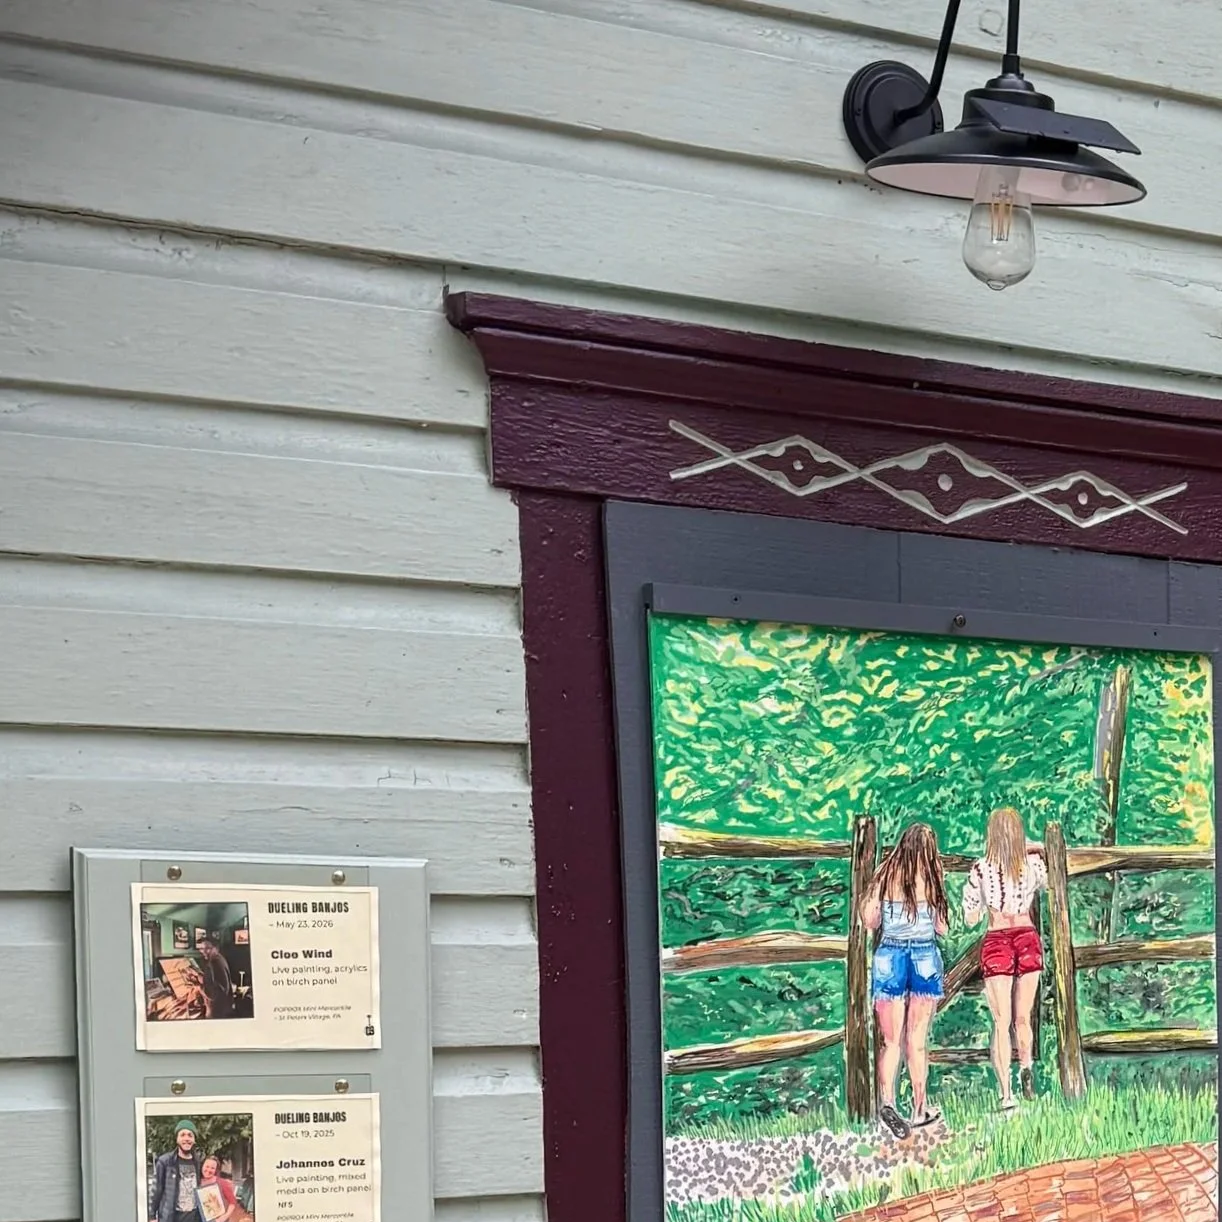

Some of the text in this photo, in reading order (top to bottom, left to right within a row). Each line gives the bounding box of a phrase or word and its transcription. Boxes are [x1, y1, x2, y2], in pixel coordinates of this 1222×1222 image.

[268, 902, 350, 914] DUELING BANJOS
[276, 921, 295, 930] May
[297, 920, 310, 929] 23,
[312, 920, 334, 928] 2026
[302, 949, 333, 959] Wind
[272, 964, 368, 975] Live painting, acrylics
[286, 977, 310, 986] birch
[312, 977, 338, 986] panel
[275, 1111, 347, 1124] DUELING BANJOS
[282, 1130, 298, 1139] Oct
[313, 1129, 335, 1138] 2025
[338, 1157, 366, 1167] Cruz
[276, 1172, 367, 1184] Live painting, mixed
[276, 1187, 305, 1196] media
[321, 1185, 344, 1193] birch
[346, 1184, 372, 1193] panel
